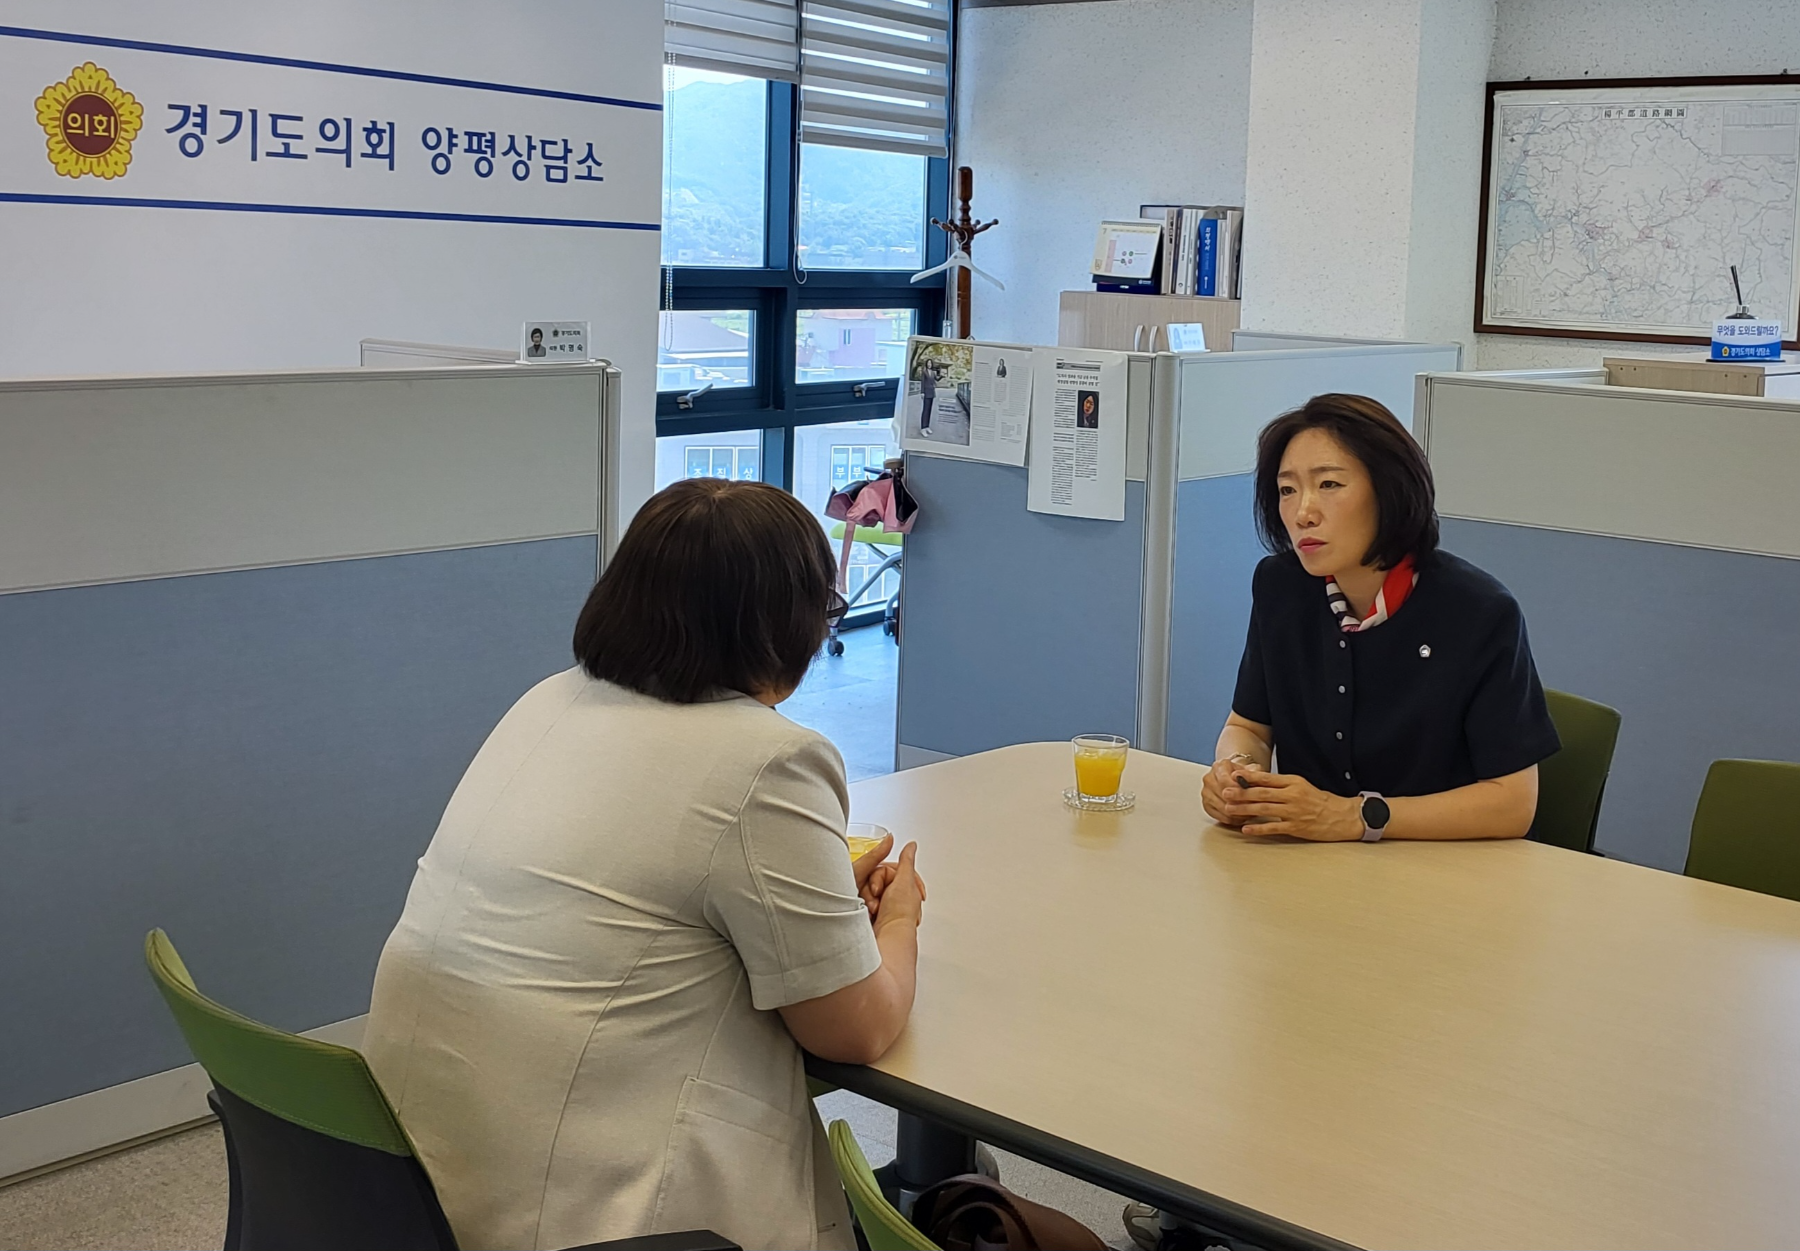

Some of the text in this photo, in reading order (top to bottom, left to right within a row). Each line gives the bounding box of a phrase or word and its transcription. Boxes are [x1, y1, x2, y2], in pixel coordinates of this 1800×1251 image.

[66, 112, 115, 138] 의회
[164, 104, 604, 183] 경기도의회 양평상담소
[1717, 325, 1779, 336] 무엇을 도와드릴까요?
[1730, 347, 1771, 357] 경기도의회 상담소
